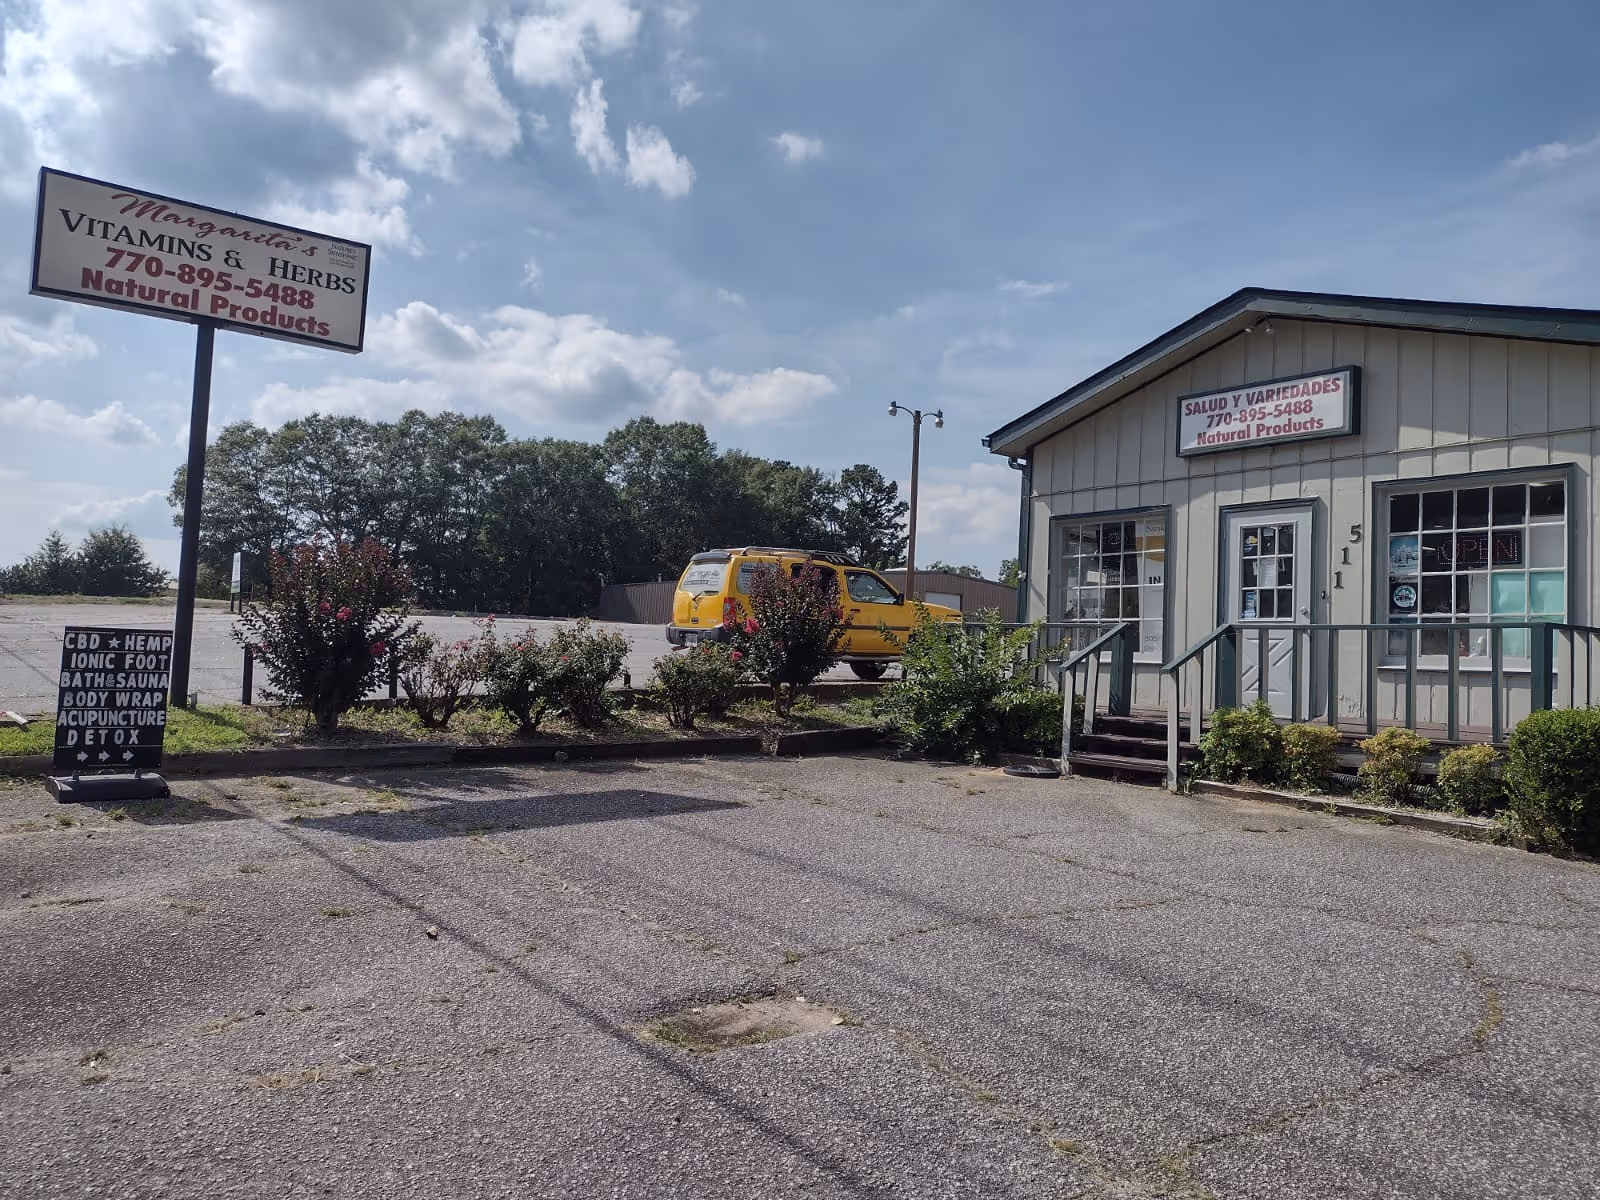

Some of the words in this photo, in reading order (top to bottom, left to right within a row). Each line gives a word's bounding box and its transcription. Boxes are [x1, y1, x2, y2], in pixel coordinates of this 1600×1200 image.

[112, 193, 318, 257] Margarita's
[58, 208, 213, 262] VITAMINS
[223, 249, 246, 270] &
[268, 256, 357, 295] HERBS
[104, 246, 315, 310] 770-895-5488
[81, 267, 199, 311] Natural
[210, 294, 331, 337] Products
[1184, 397, 1228, 417] SALUD
[1232, 394, 1242, 408] Y
[1245, 377, 1341, 406] VARIEDADES
[1206, 399, 1313, 429] 770-895-5488
[1197, 426, 1251, 446] Natural
[1256, 416, 1324, 438] Products
[1440, 536, 1514, 561] OPEN
[64, 633, 100, 650] CBD
[124, 634, 172, 651] HEMP
[70, 652, 116, 669] IONIC
[124, 653, 168, 670] FOOT
[63, 691, 109, 707] BODY
[115, 691, 163, 707] WRAP
[57, 710, 166, 727] ACUPUNCTURE
